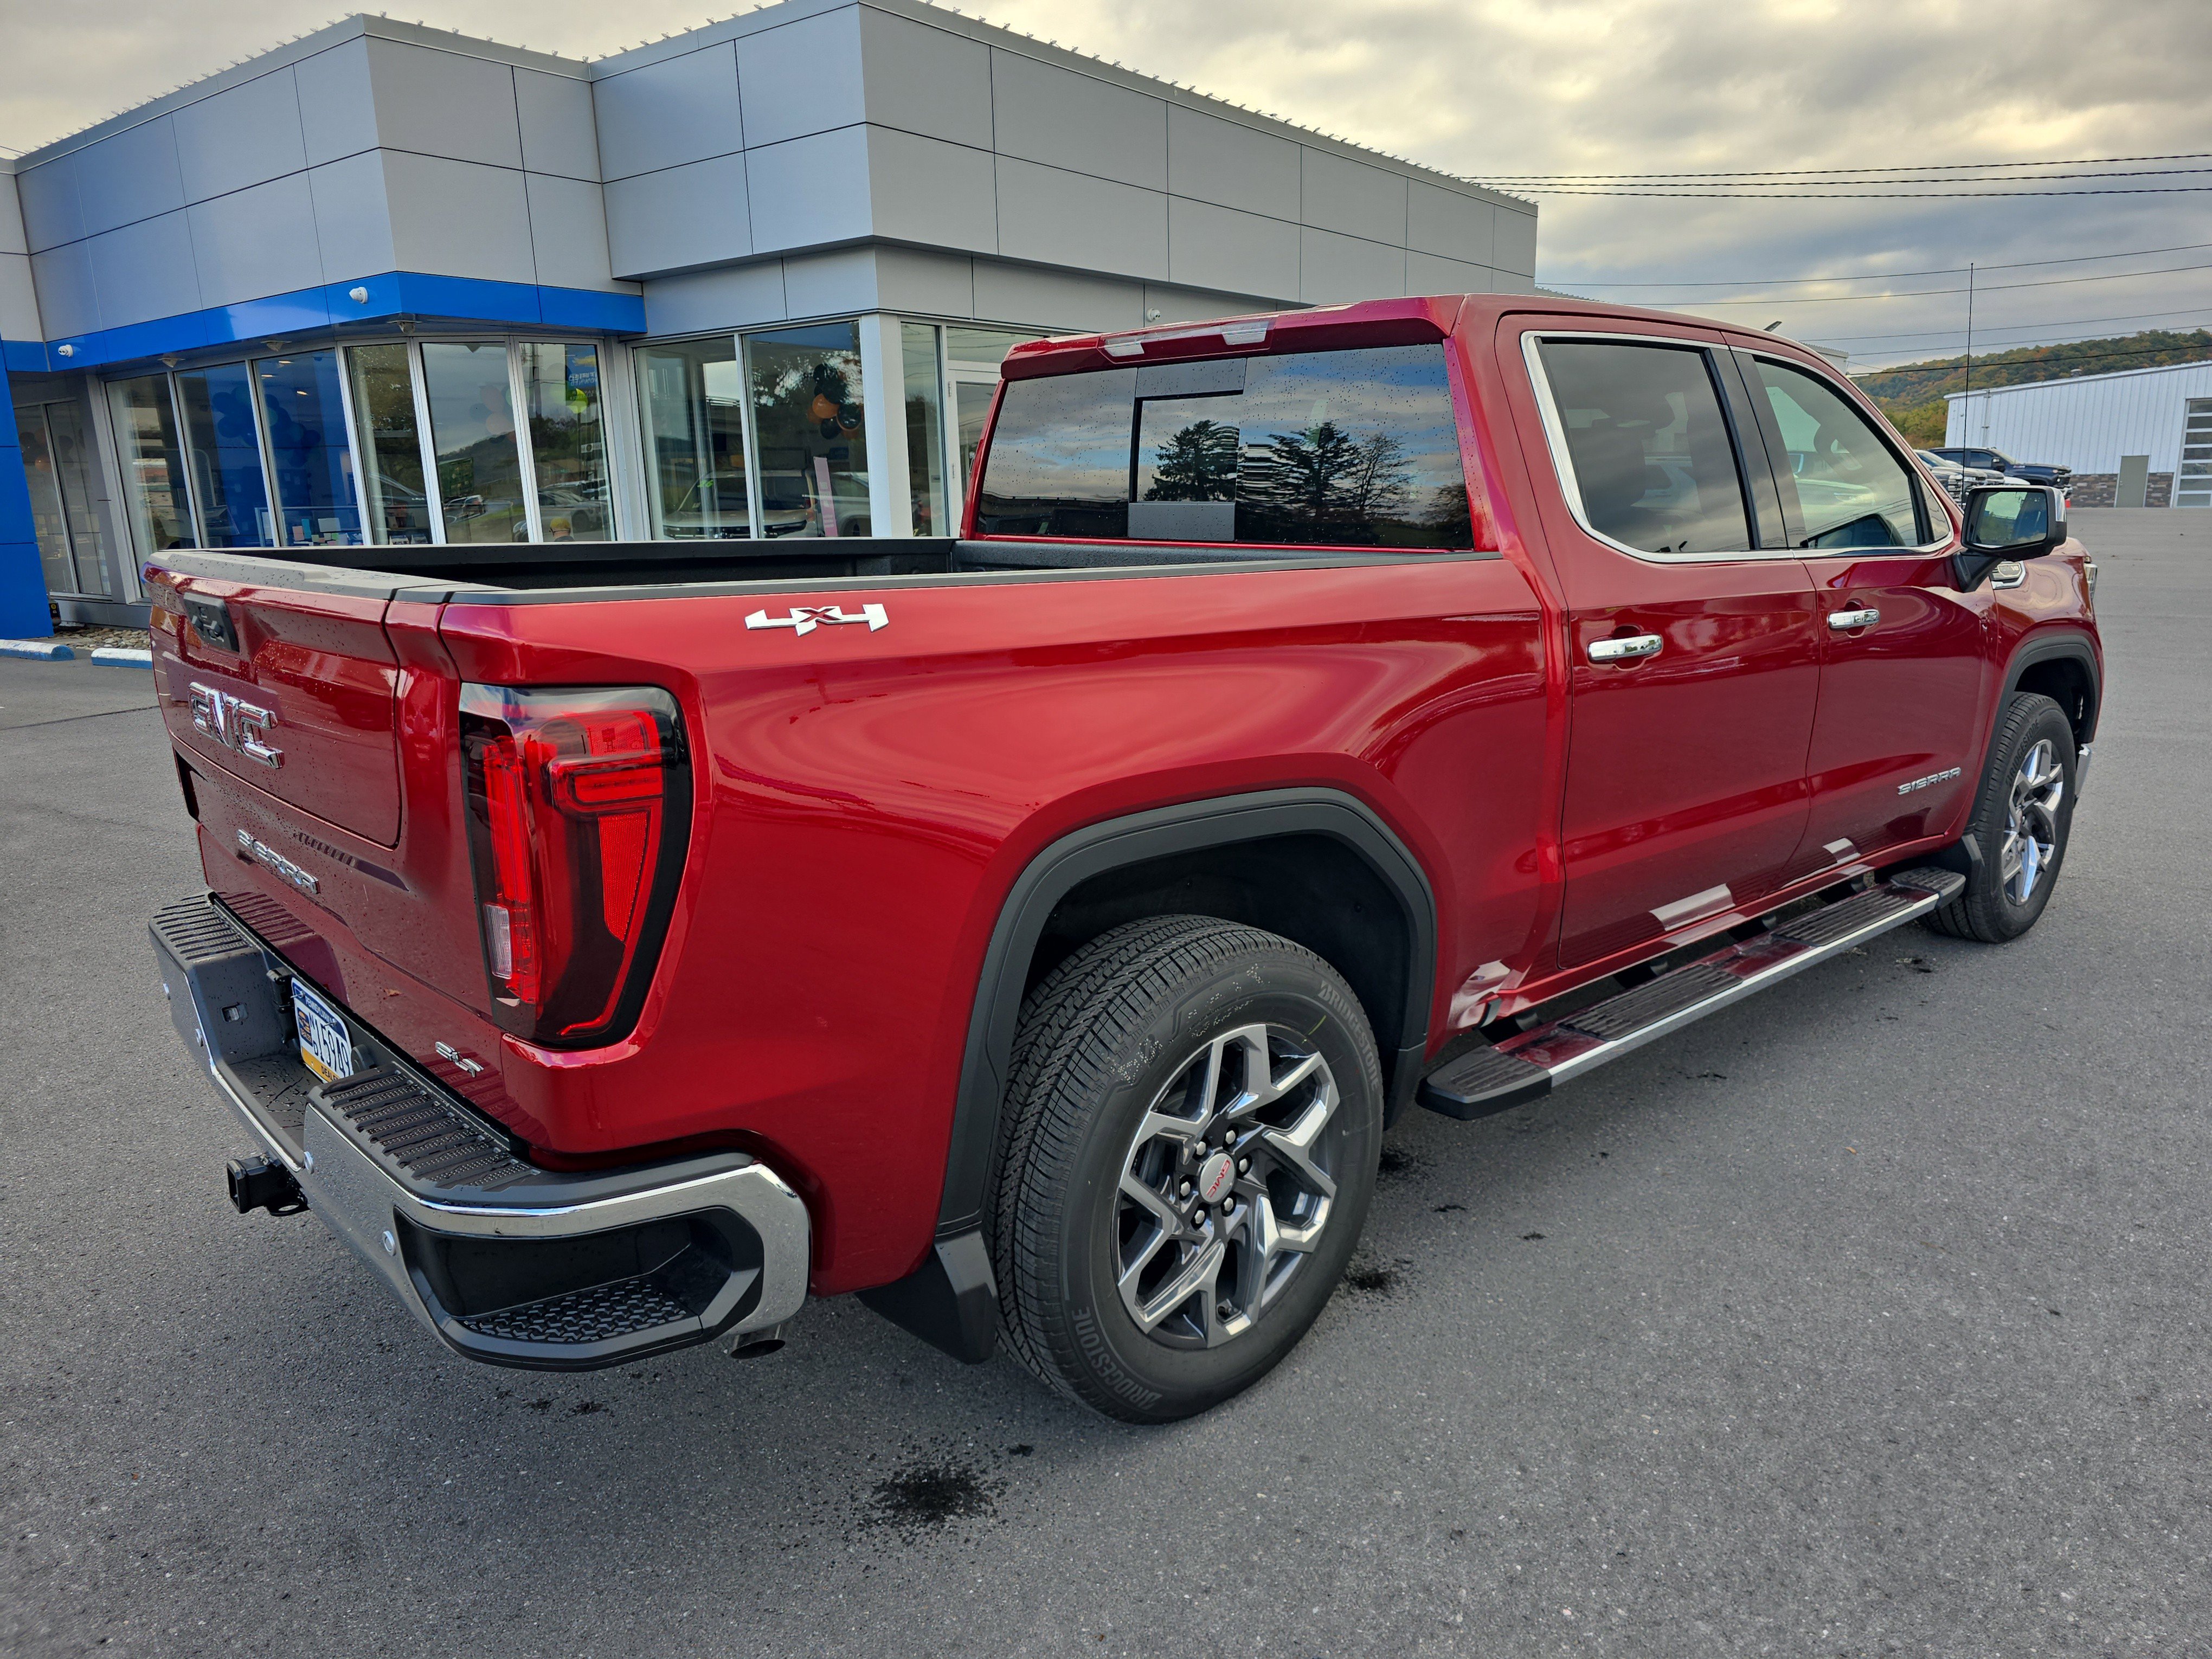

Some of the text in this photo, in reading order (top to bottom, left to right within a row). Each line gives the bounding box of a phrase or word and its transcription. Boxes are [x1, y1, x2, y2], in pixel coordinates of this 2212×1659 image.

[188, 681, 286, 769] GMC
[2006, 719, 2039, 786] BRIDGESTONE
[1898, 767, 1962, 795] SIERRA
[235, 828, 321, 895] SIERRA
[435, 1041, 485, 1078] SLT
[1318, 980, 1379, 1091] BRIDGESTONE
[321, 1065, 339, 1081] DEALE
[1206, 1158, 1231, 1198] GMC
[1071, 1306, 1163, 1410] BRIDGESTONE
